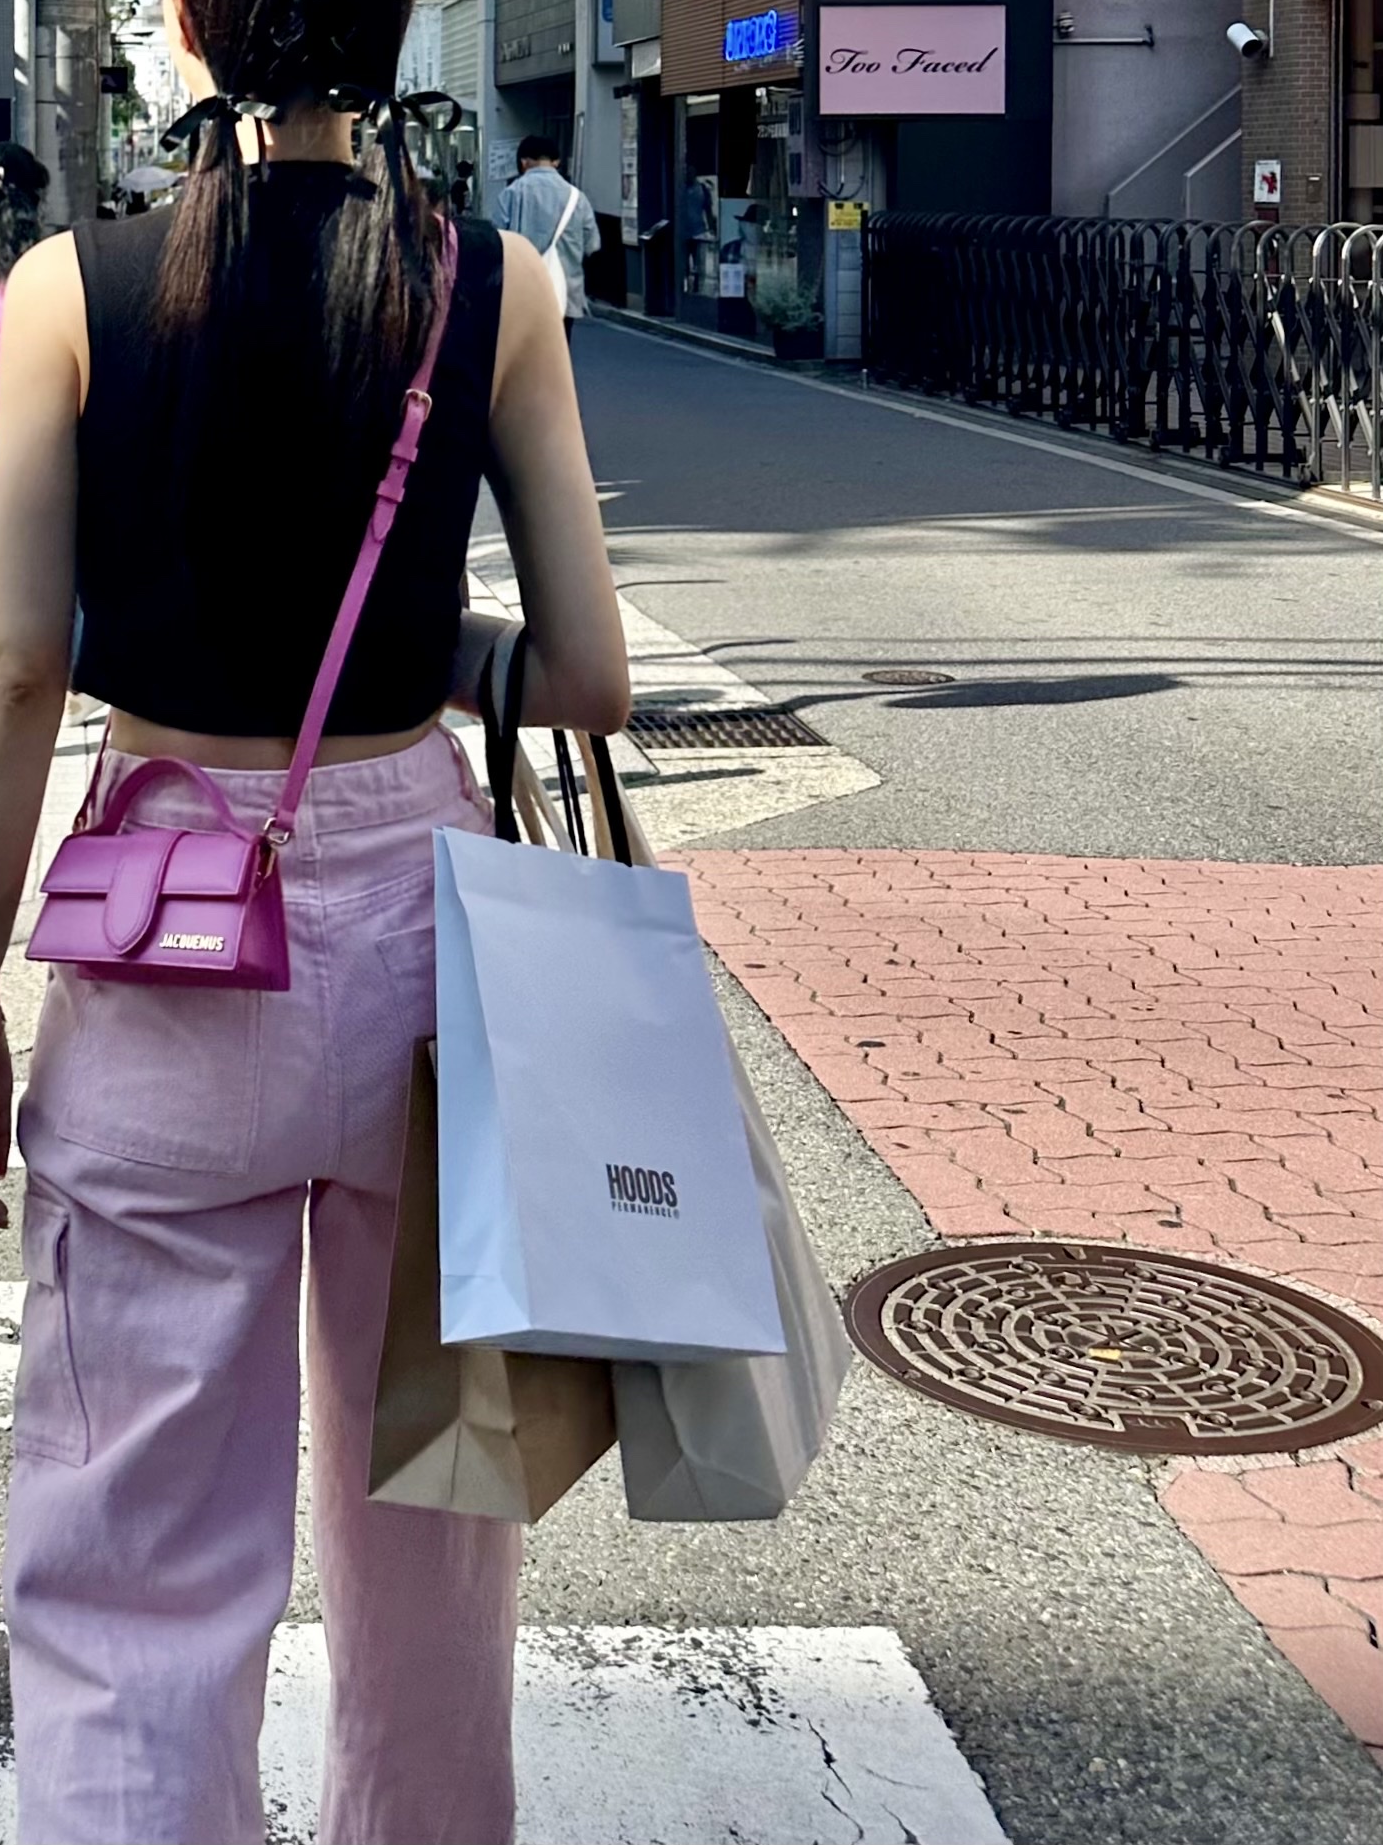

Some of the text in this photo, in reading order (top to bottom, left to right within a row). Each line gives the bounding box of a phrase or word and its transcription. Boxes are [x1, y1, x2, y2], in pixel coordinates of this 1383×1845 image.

[825, 48, 881, 74] Too
[891, 47, 999, 74] Faced
[159, 933, 225, 952] JACQUEMUS
[605, 1163, 678, 1208] HOODS
